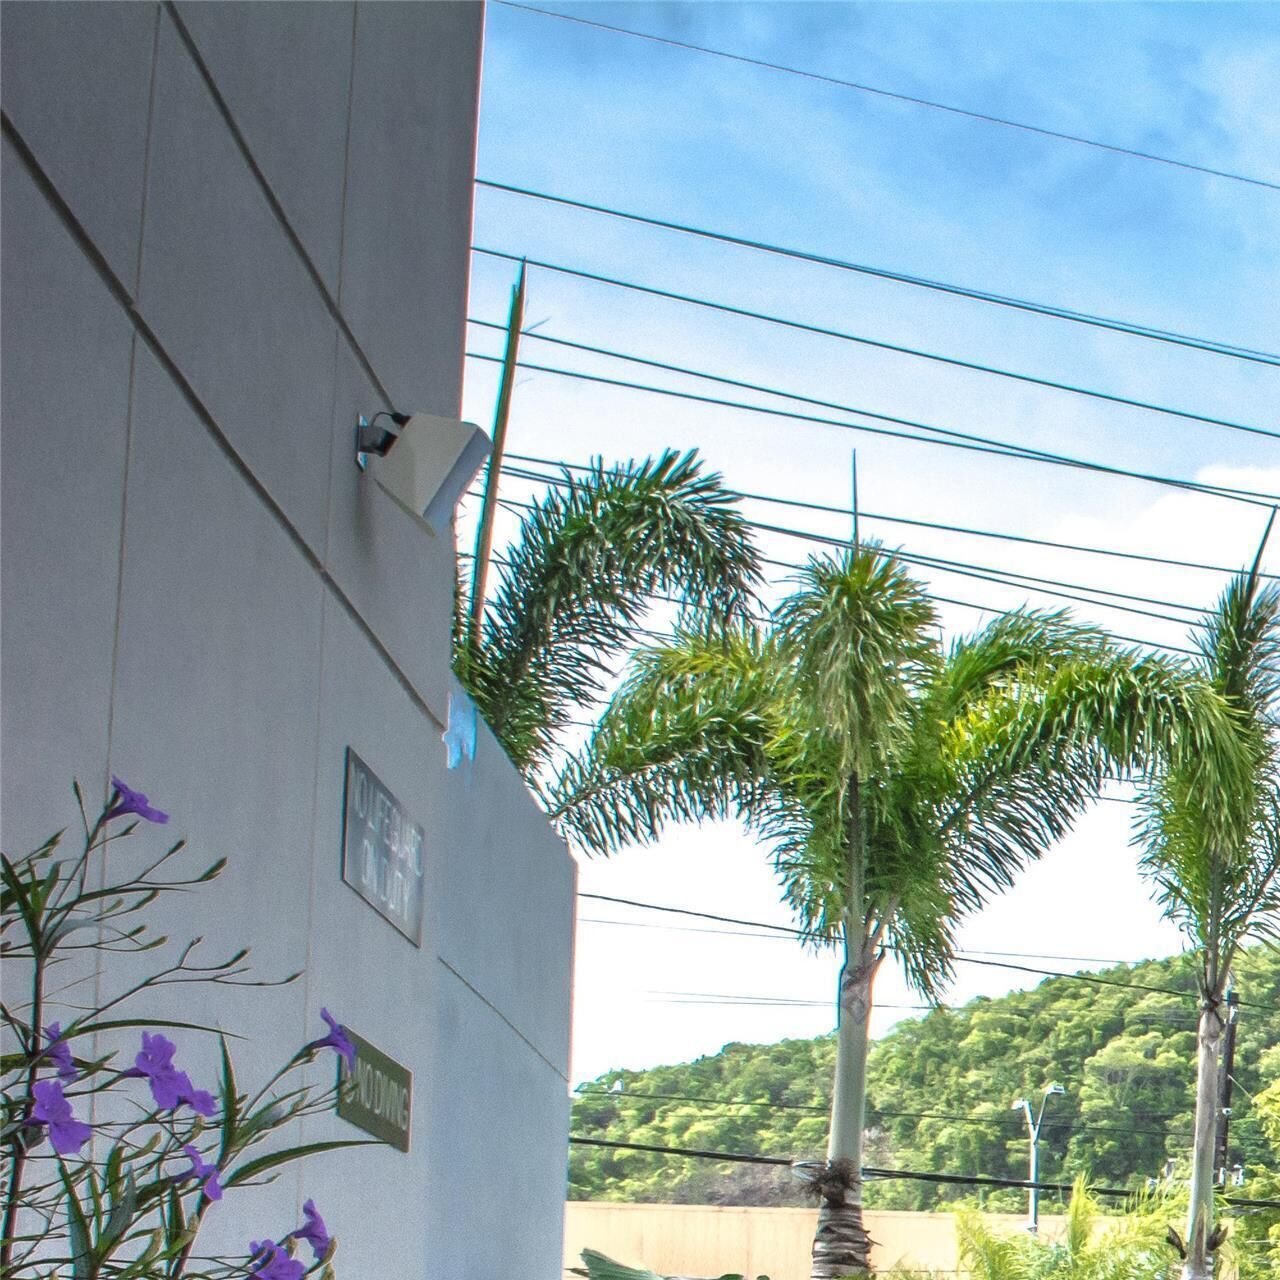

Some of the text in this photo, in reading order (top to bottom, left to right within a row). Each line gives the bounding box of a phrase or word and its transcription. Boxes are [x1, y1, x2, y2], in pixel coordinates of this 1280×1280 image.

[351, 762, 369, 819] NO
[357, 1056, 409, 1132] NO DIVING
